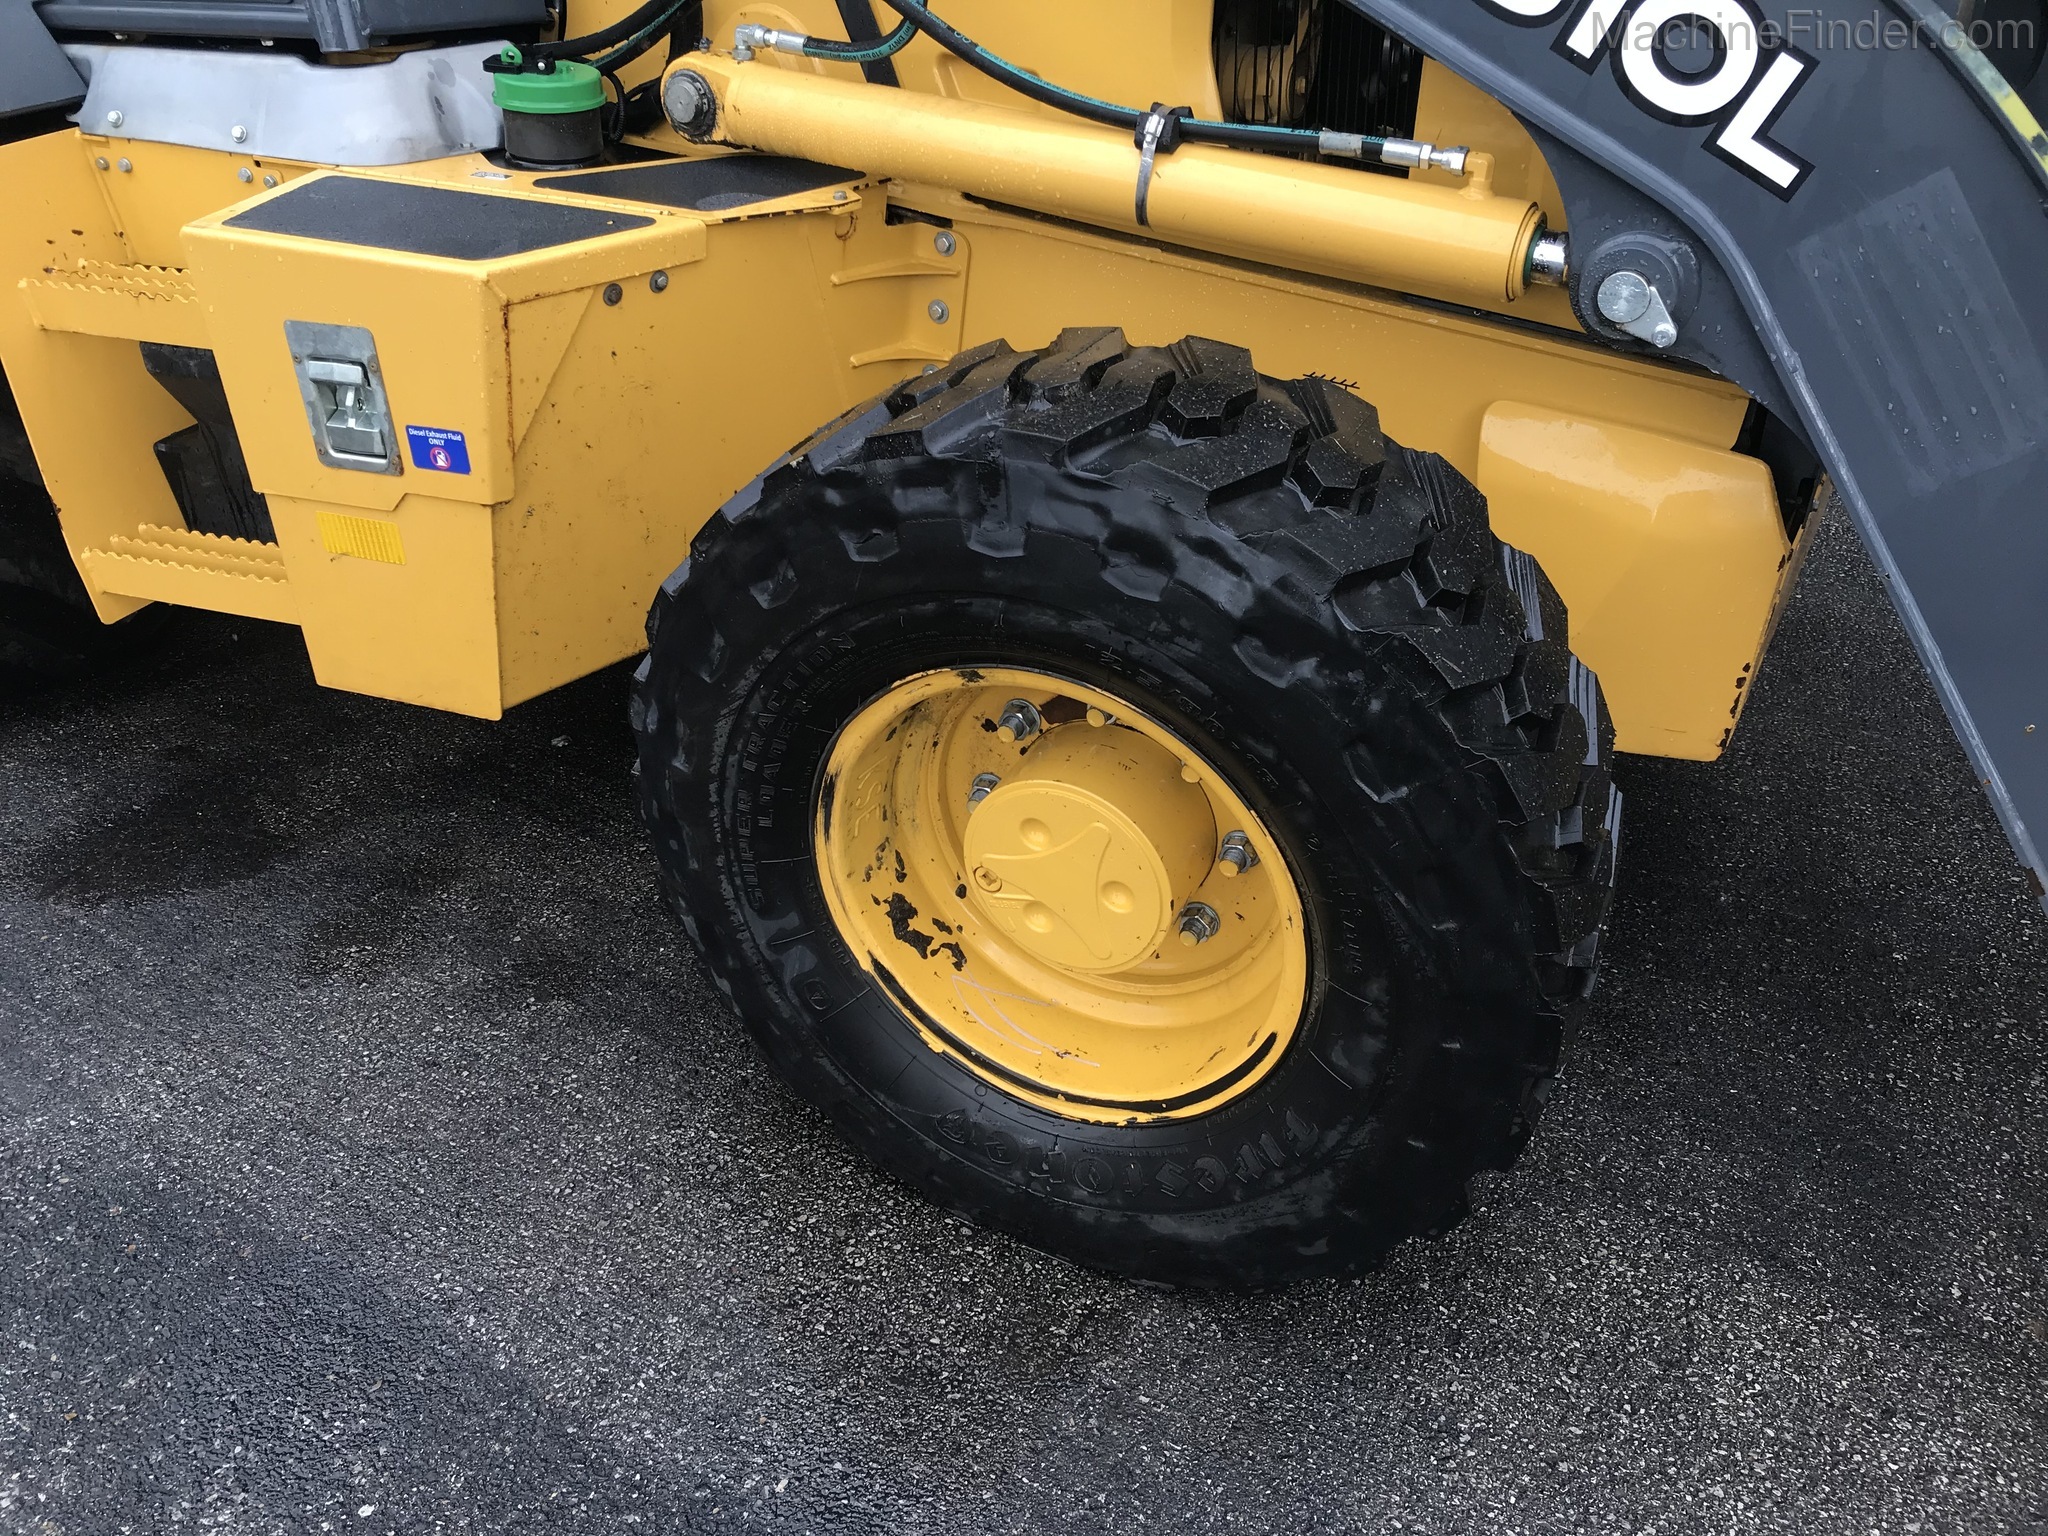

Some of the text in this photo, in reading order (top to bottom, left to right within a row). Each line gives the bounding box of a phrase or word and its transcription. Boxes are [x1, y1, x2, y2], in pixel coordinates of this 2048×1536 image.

[408, 428, 462, 441] Diesel Exhaust Fluid
[428, 437, 445, 446] ONLY
[734, 631, 858, 913] SUPER TRACTION
